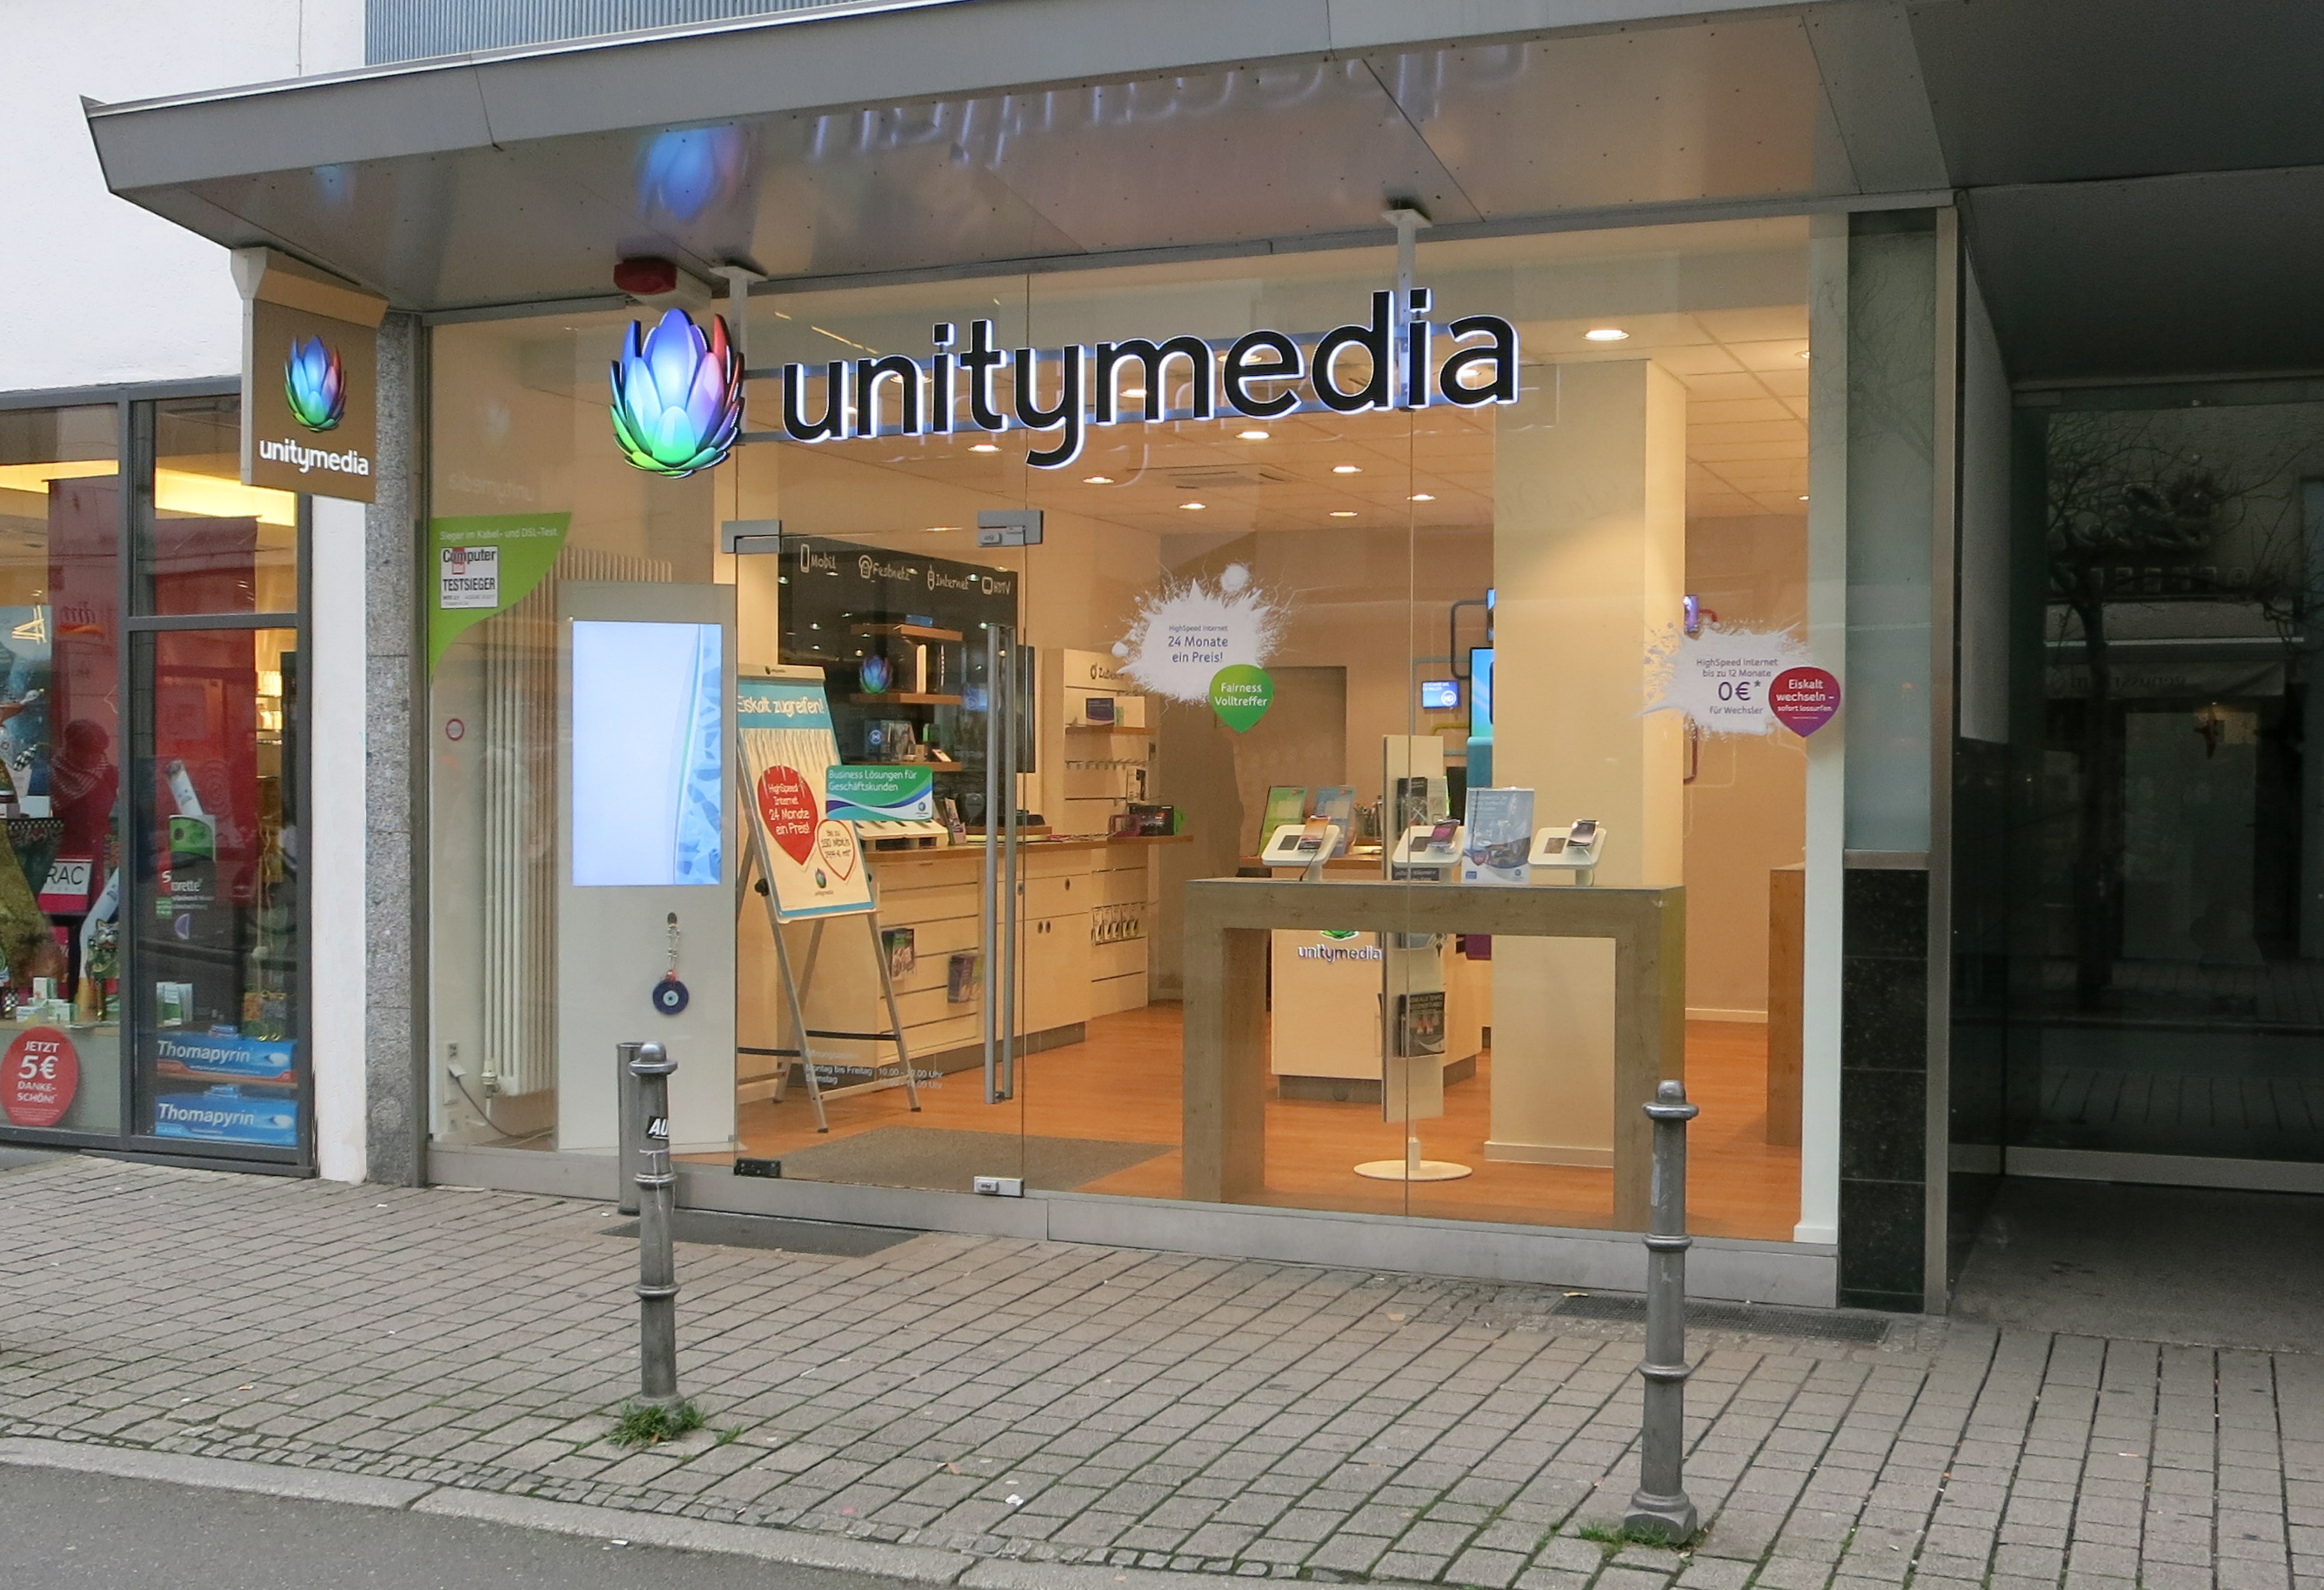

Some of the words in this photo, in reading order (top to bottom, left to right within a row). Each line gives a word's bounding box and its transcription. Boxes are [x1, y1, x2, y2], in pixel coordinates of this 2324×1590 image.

[783, 289, 1522, 471] unitymedia
[259, 438, 370, 476] unitymedia
[443, 550, 496, 565] Computer
[811, 553, 837, 570] Mobil
[935, 574, 969, 591] Internet
[443, 578, 496, 591] TESTSIEGER
[1169, 625, 1201, 633] HighSpeed
[1168, 636, 1182, 647] 24
[1185, 636, 1229, 647] Monate
[1172, 652, 1189, 663] ein
[1192, 651, 1223, 663] Preis!
[1697, 658, 1741, 668] HighSpeed
[1220, 682, 1262, 693] Fairness
[1788, 678, 1824, 689] Eiskalt
[1214, 695, 1268, 707] Volltreffer
[1776, 691, 1826, 702] wechseln
[828, 771, 863, 779] Business
[865, 770, 903, 782] Lösungen
[905, 770, 917, 779] für
[829, 782, 898, 792] Geschäftskunden
[769, 809, 779, 821] 24
[781, 807, 811, 819] Monate
[776, 825, 788, 835] ein
[1298, 944, 1383, 963] unitymedia
[24, 1040, 59, 1053] JETZT
[157, 1040, 250, 1065] Thomapyrin
[18, 1054, 58, 1079] 5€
[834, 1066, 845, 1074] bis
[846, 1066, 873, 1077] Freitag
[17, 1080, 57, 1092] DANKE-
[158, 1103, 255, 1127] Thomapyrin
